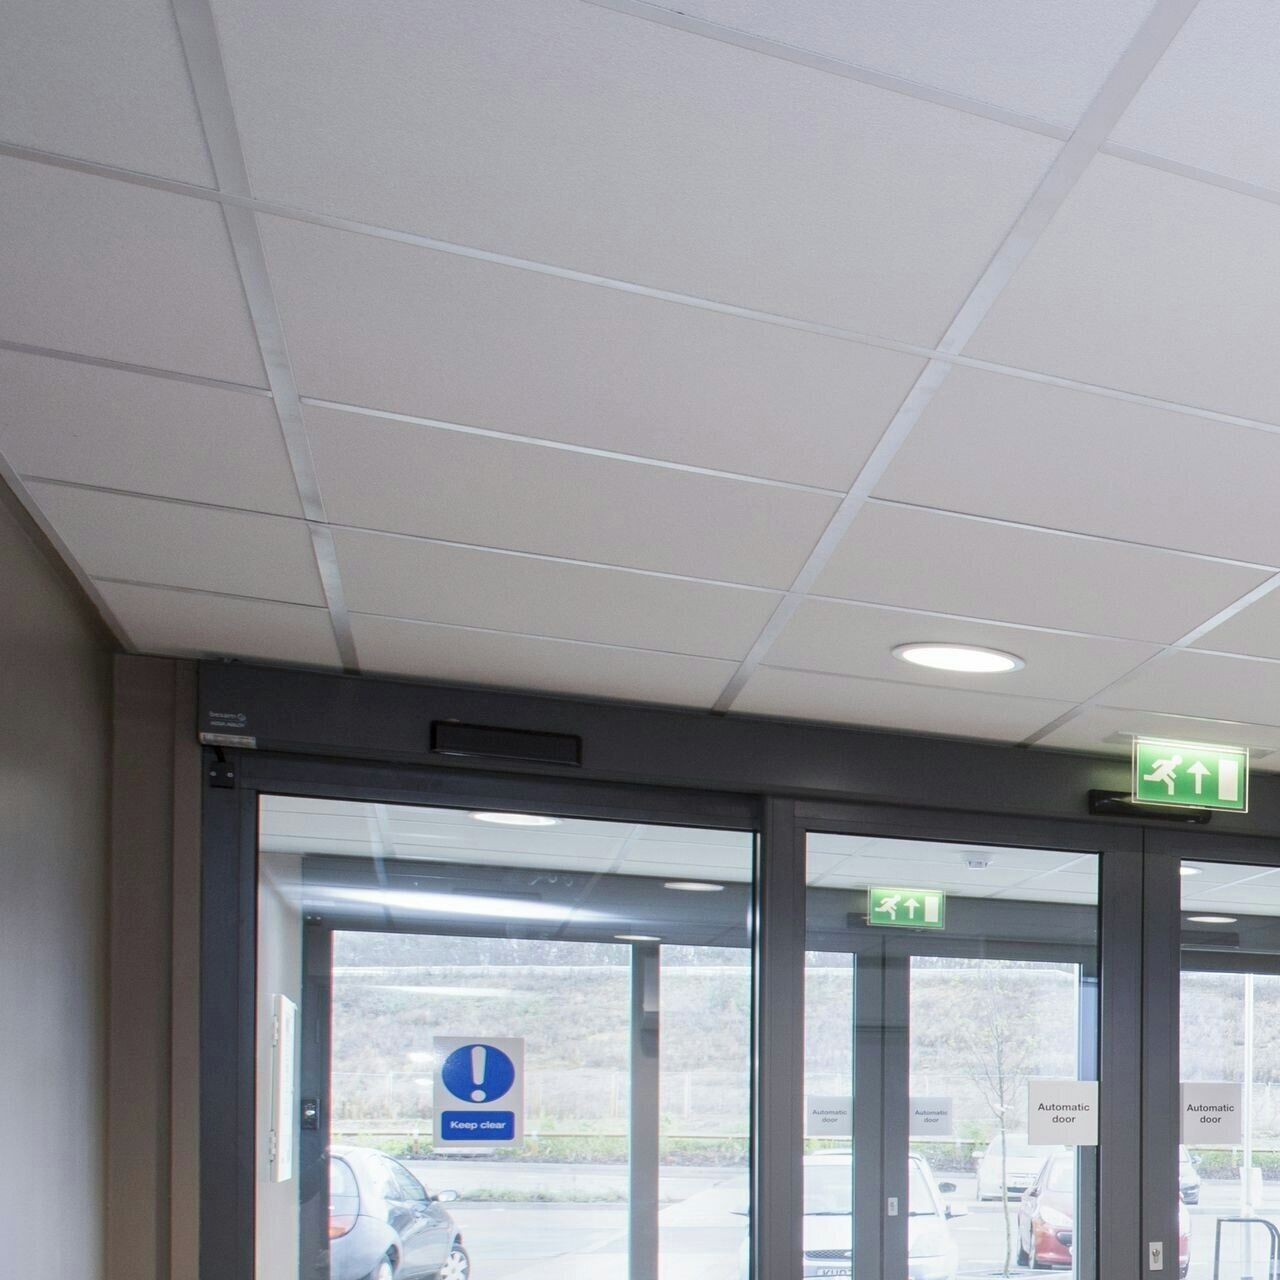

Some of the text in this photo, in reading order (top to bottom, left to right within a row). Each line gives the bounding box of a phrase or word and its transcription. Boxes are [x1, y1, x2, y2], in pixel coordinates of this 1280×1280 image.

[1037, 1102, 1091, 1112] Automatic
[1186, 1103, 1235, 1113] Automatic
[1051, 1114, 1077, 1124] door
[1199, 1115, 1222, 1124] door
[449, 1121, 507, 1131] Keep clear
